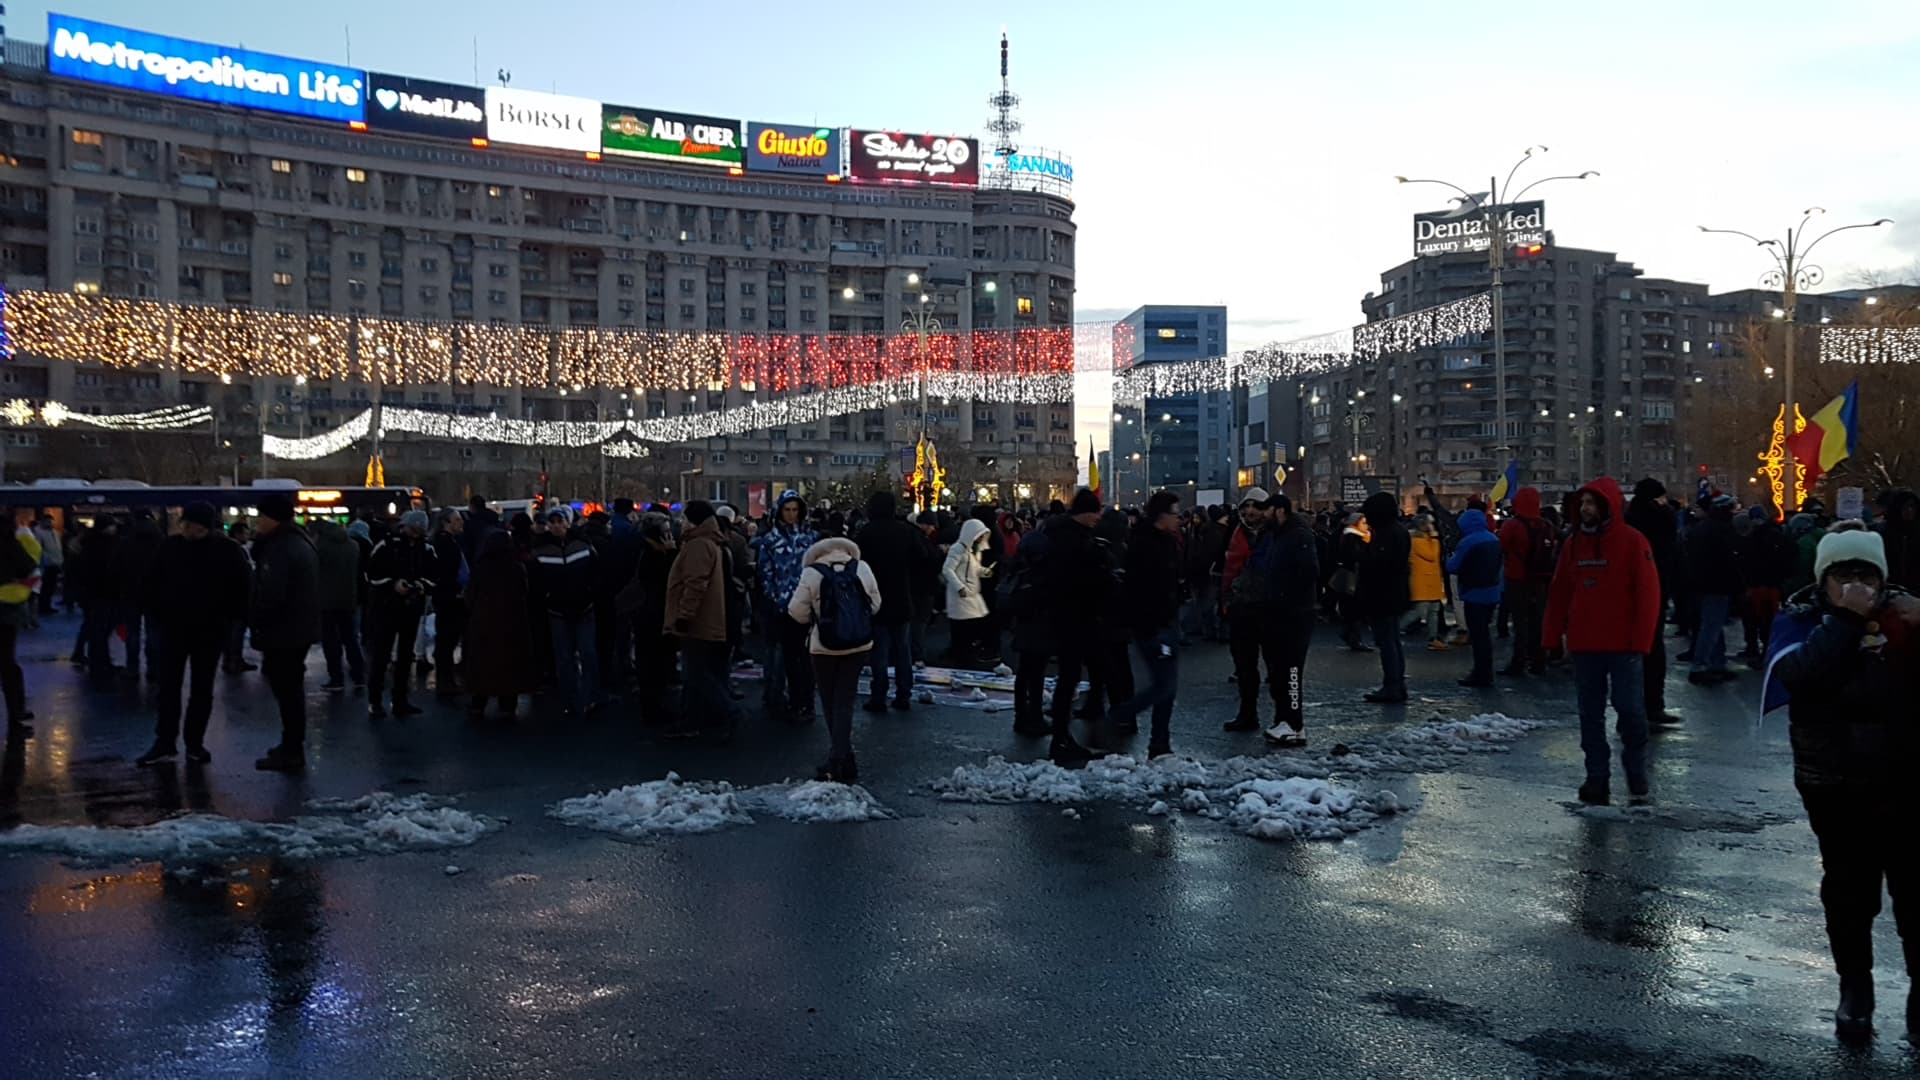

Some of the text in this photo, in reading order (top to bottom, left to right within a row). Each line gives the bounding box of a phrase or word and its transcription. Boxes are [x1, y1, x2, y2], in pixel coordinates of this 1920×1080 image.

[54, 28, 359, 106] Metropolitan Life
[499, 102, 587, 133] BORSEC
[758, 128, 829, 157] Giusto
[932, 138, 969, 165] 20
[776, 155, 822, 169] Natura
[1008, 154, 1073, 182] SANADOR
[1416, 230, 1543, 254] Luxury Dent Clinic
[1288, 666, 1299, 710] adidas
